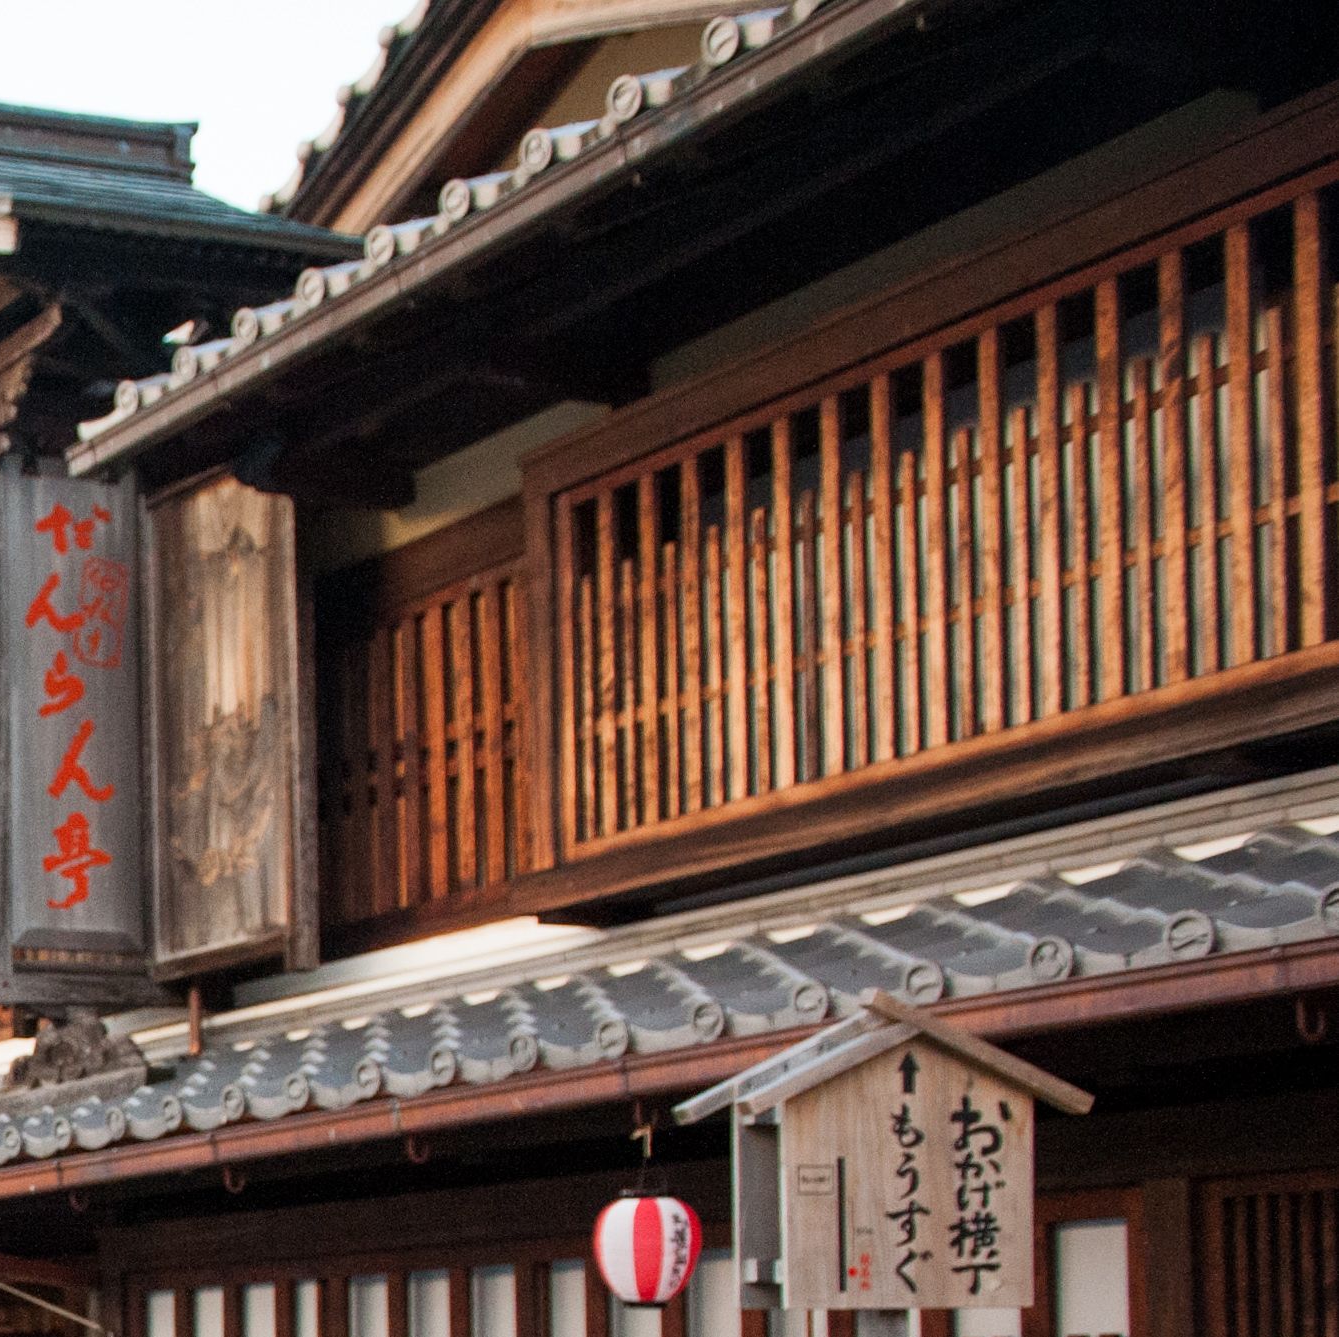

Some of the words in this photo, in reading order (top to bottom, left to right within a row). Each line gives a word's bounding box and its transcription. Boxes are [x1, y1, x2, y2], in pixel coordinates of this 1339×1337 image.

[26, 505, 114, 909] だんらん亭
[885, 1103, 933, 1293] もうすぐ
[947, 1094, 1013, 1295] おかげ横丁
